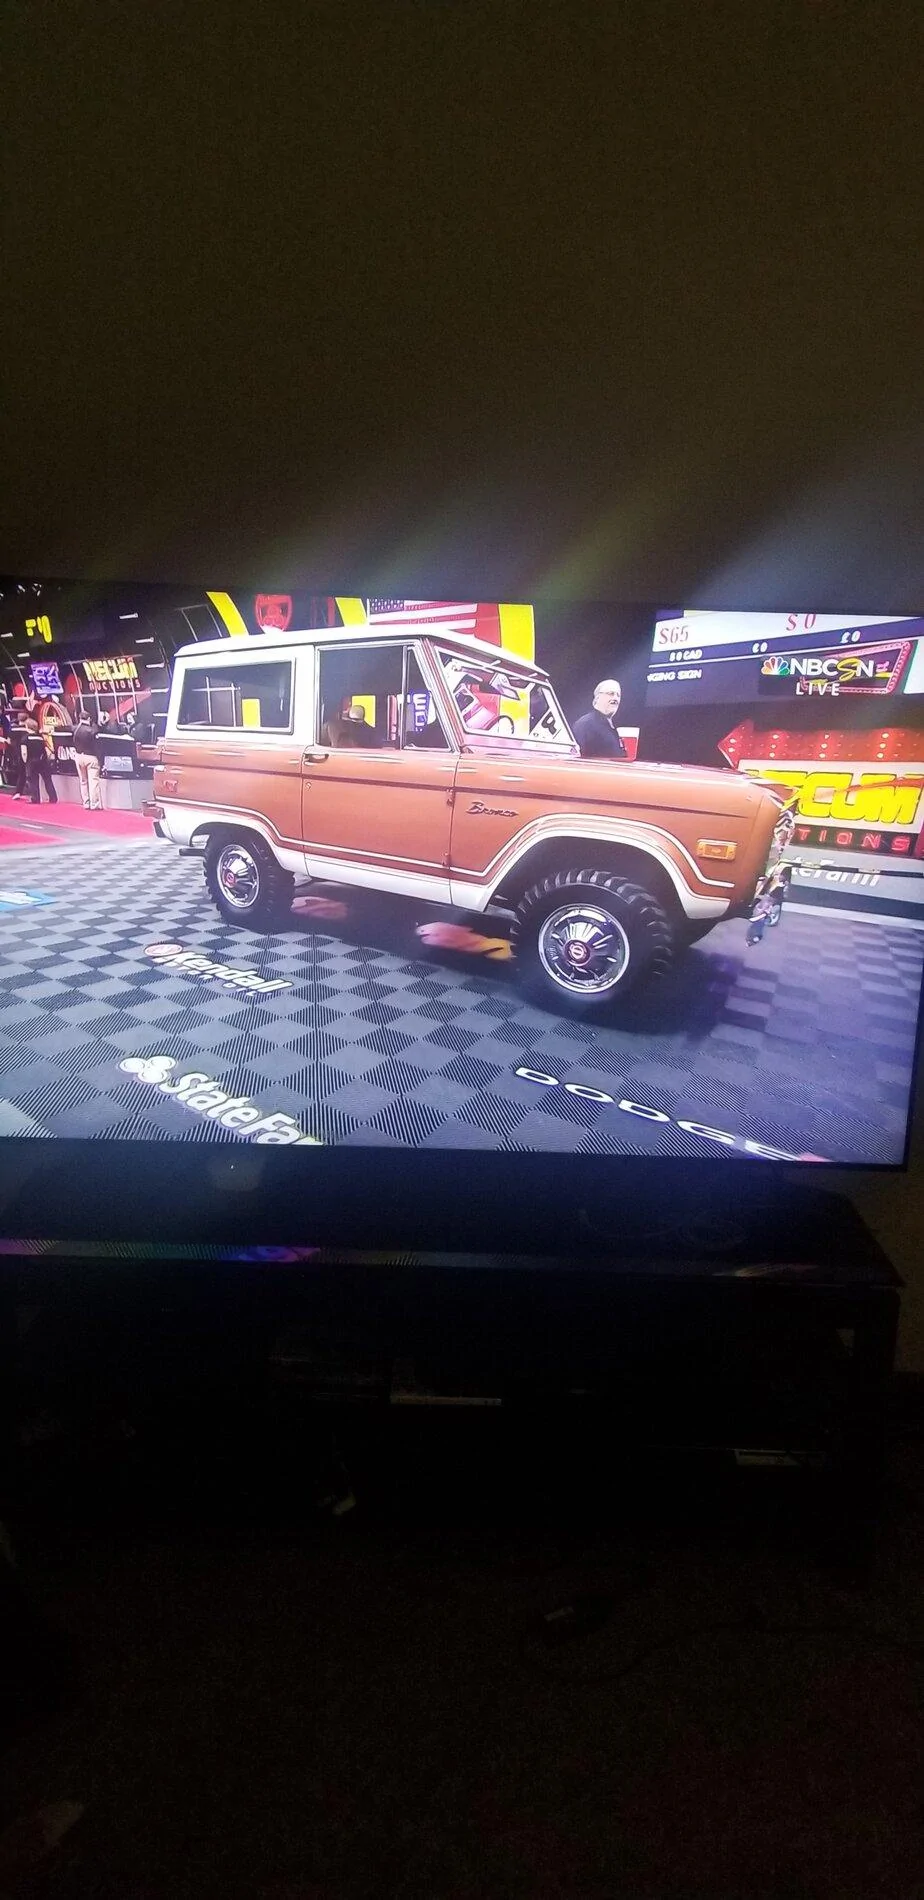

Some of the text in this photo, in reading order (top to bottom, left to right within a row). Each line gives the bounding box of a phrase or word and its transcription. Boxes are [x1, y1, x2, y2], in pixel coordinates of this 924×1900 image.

[790, 656, 874, 682] NBCSN
[795, 682, 840, 696] LIVE
[465, 801, 519, 818] Bronco
[158, 951, 294, 993] Kendall
[515, 1066, 802, 1162] DODGE
